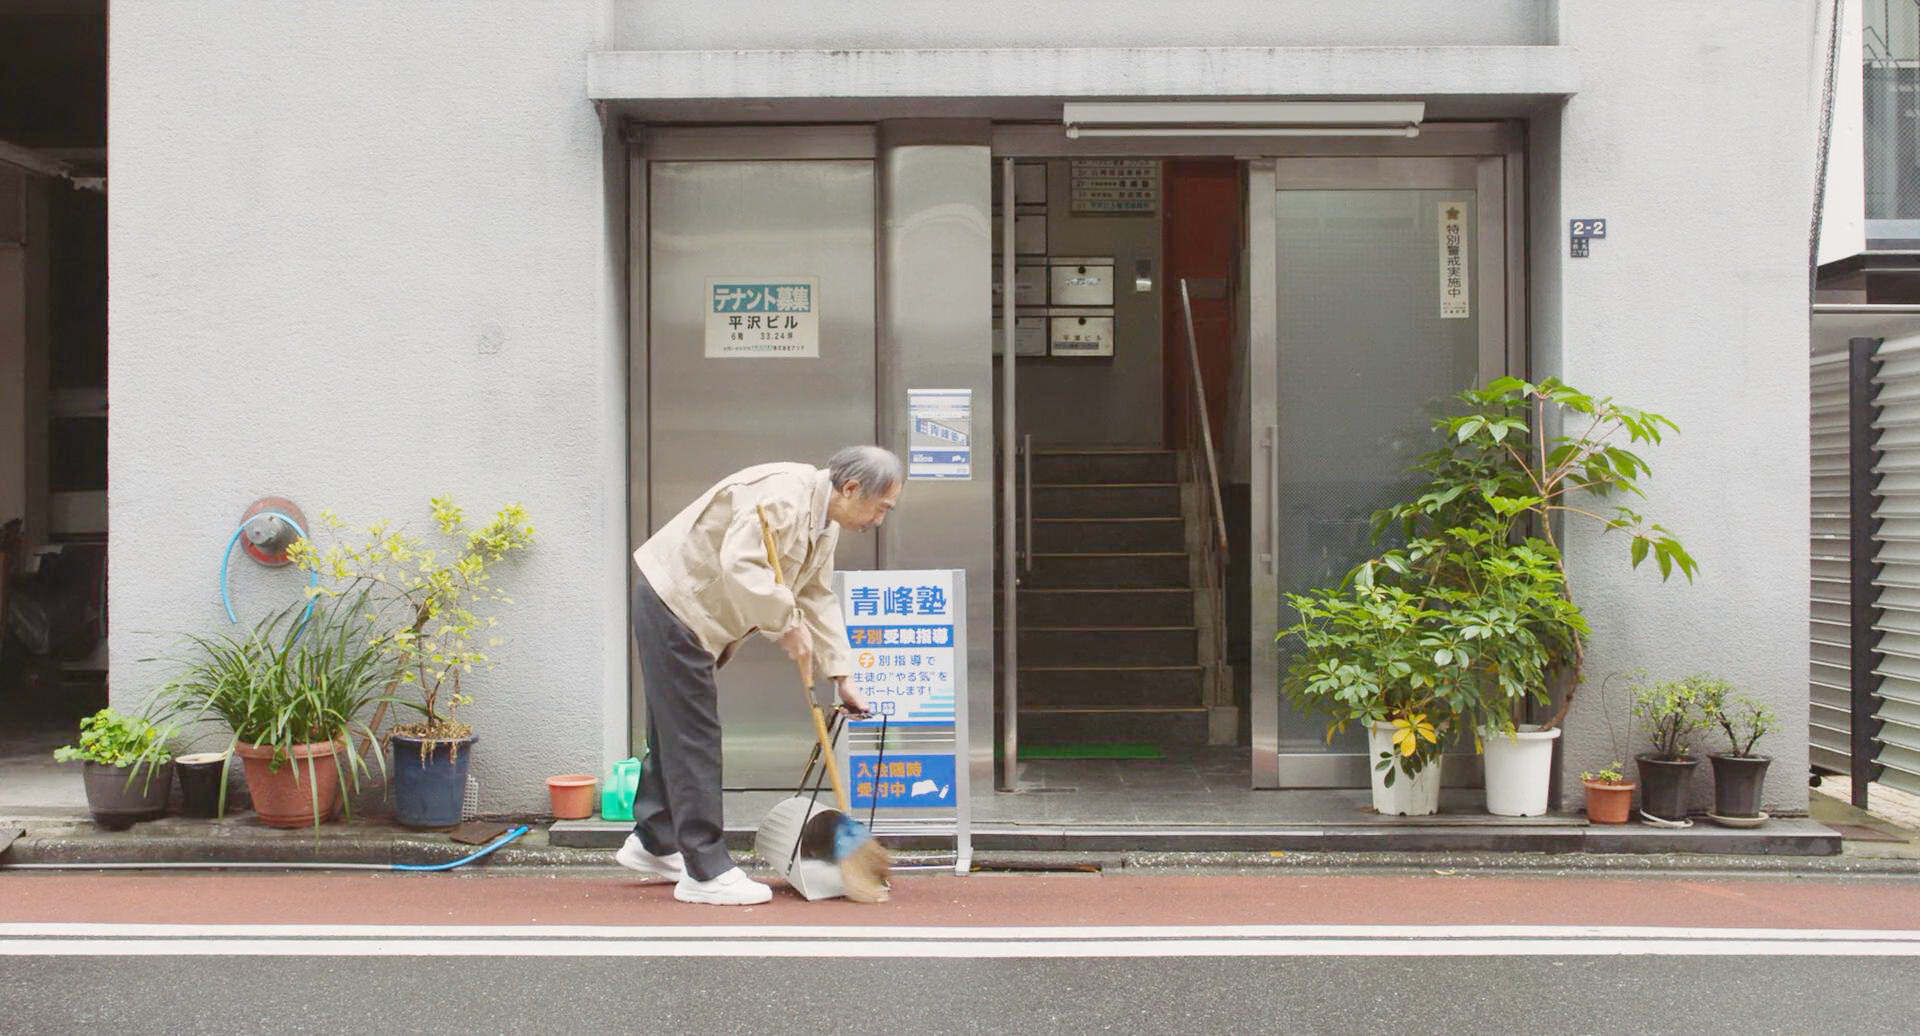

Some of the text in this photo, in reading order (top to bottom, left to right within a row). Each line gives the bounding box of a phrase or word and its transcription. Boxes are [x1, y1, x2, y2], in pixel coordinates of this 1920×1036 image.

[1574, 221, 1604, 235] 2-2
[714, 287, 809, 311] テナント募集
[728, 315, 799, 330] 平沢ビル
[850, 585, 947, 616] 青峰塾
[857, 781, 906, 798] 受付中
